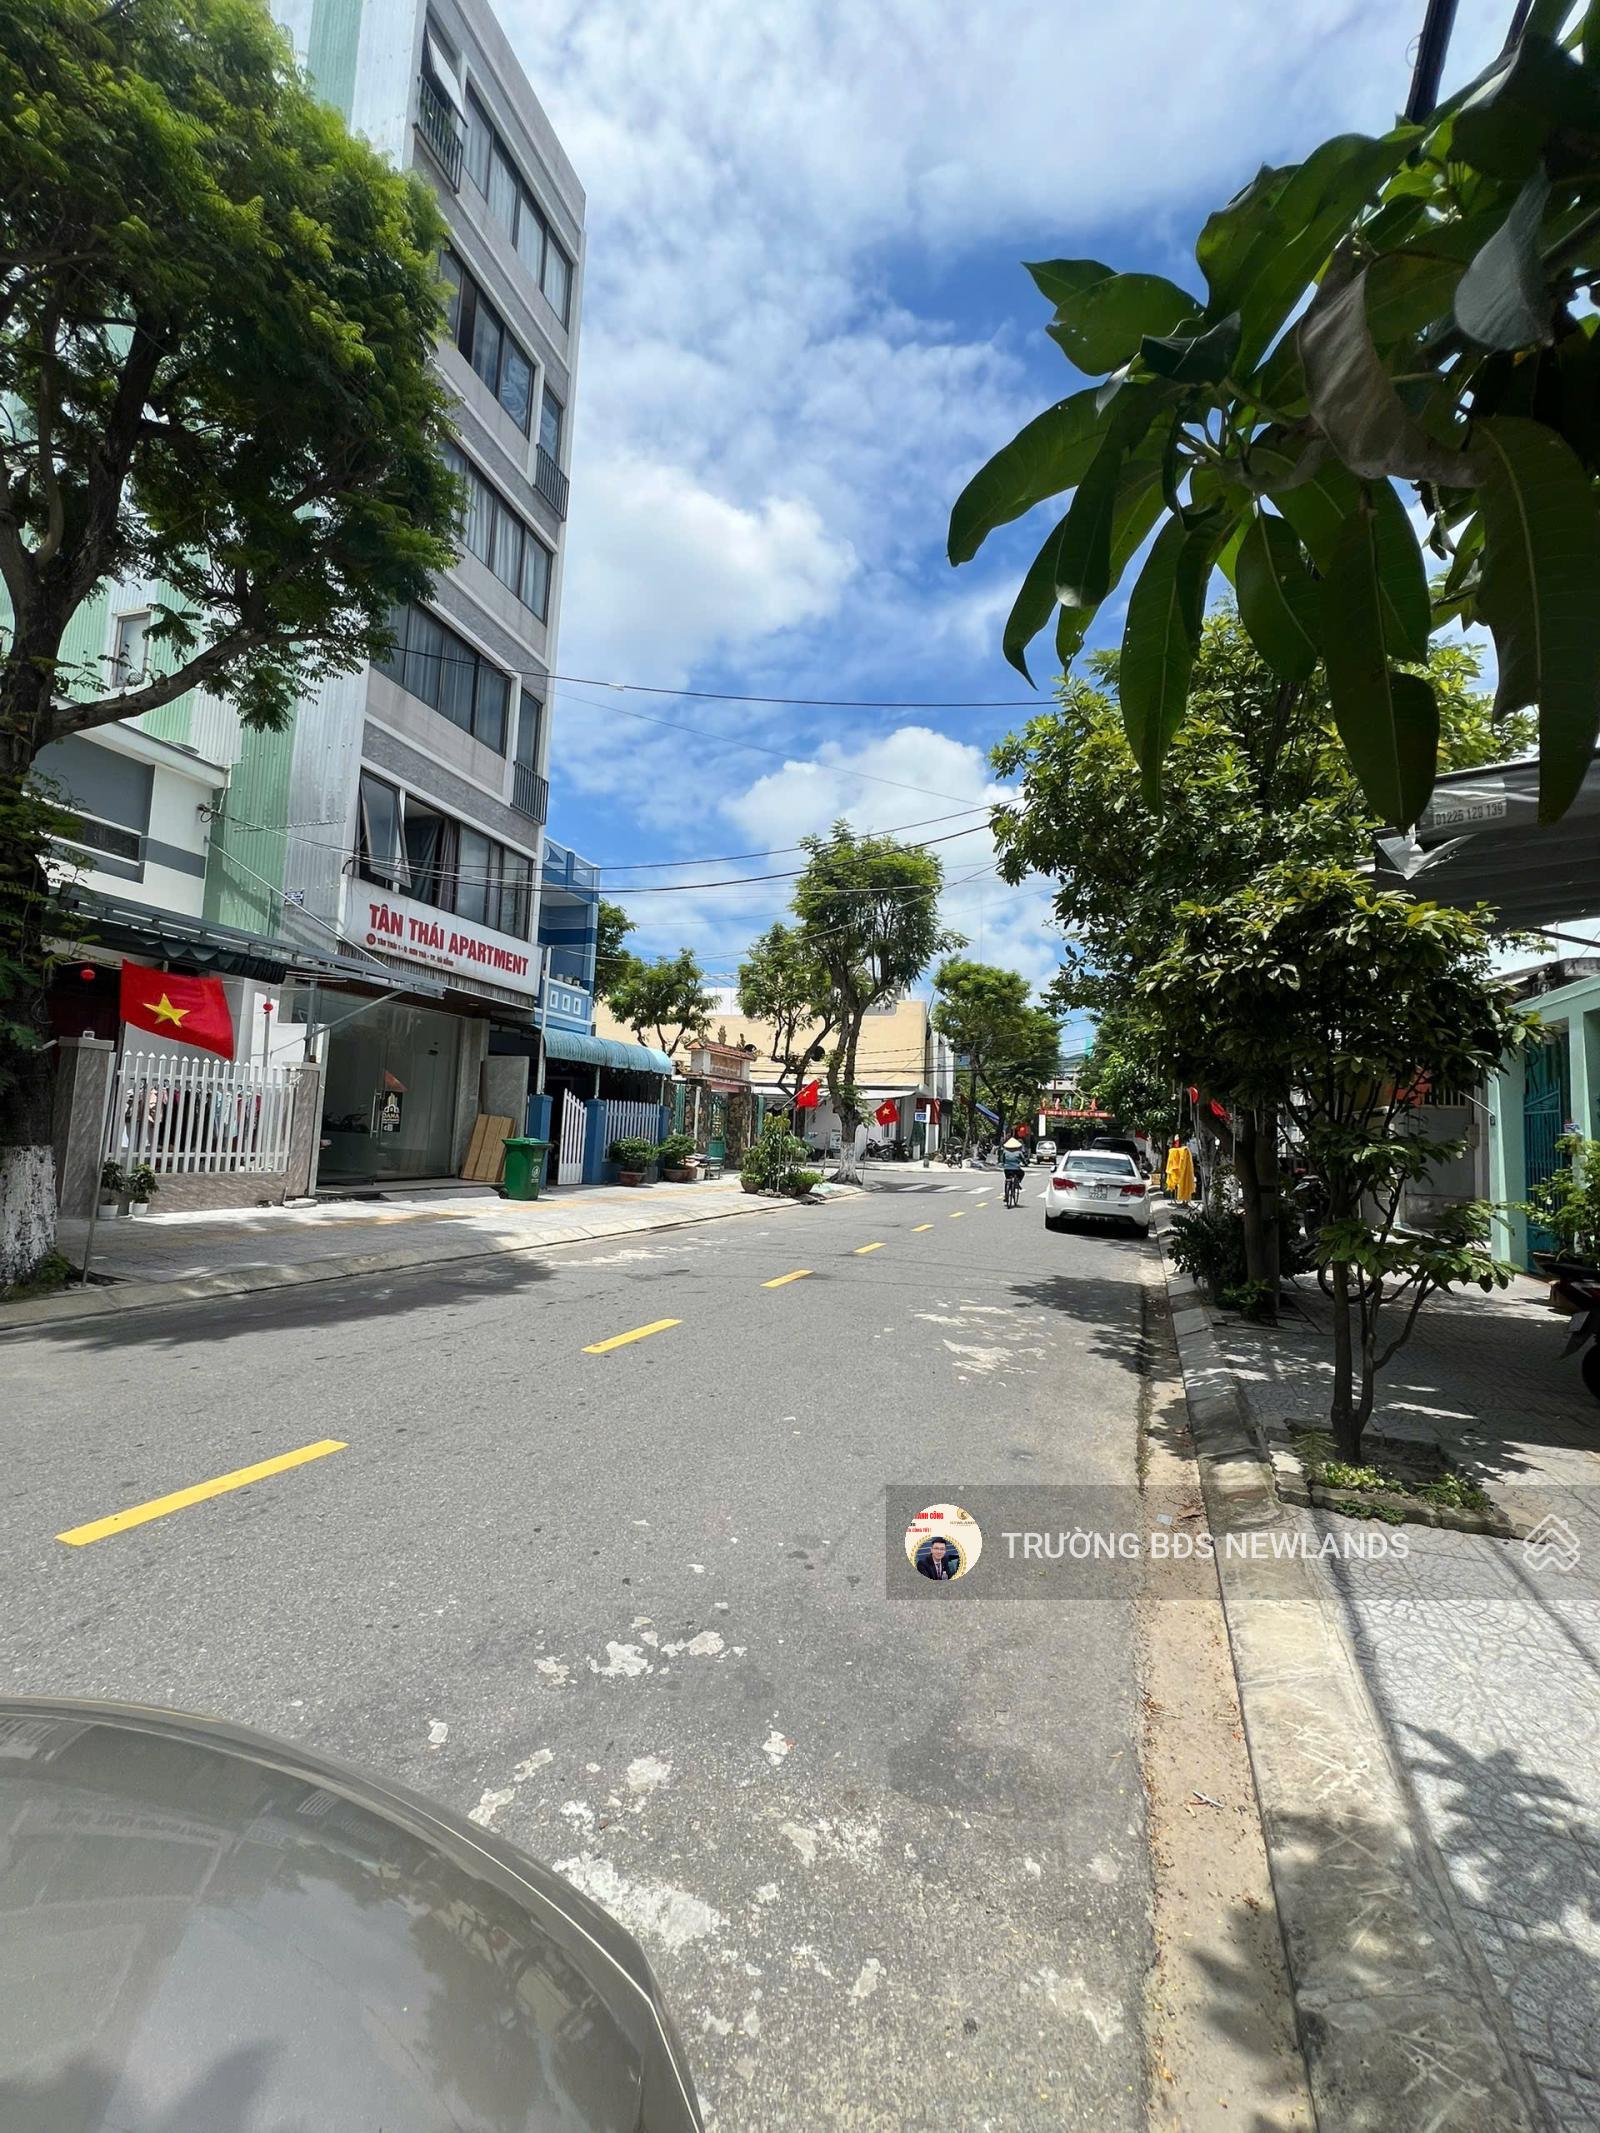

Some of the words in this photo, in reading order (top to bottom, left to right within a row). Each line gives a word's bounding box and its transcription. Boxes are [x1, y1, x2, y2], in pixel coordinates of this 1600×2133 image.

[369, 903, 404, 937] TÂN
[409, 917, 445, 950] THÁI
[448, 932, 529, 976] APARTMENT
